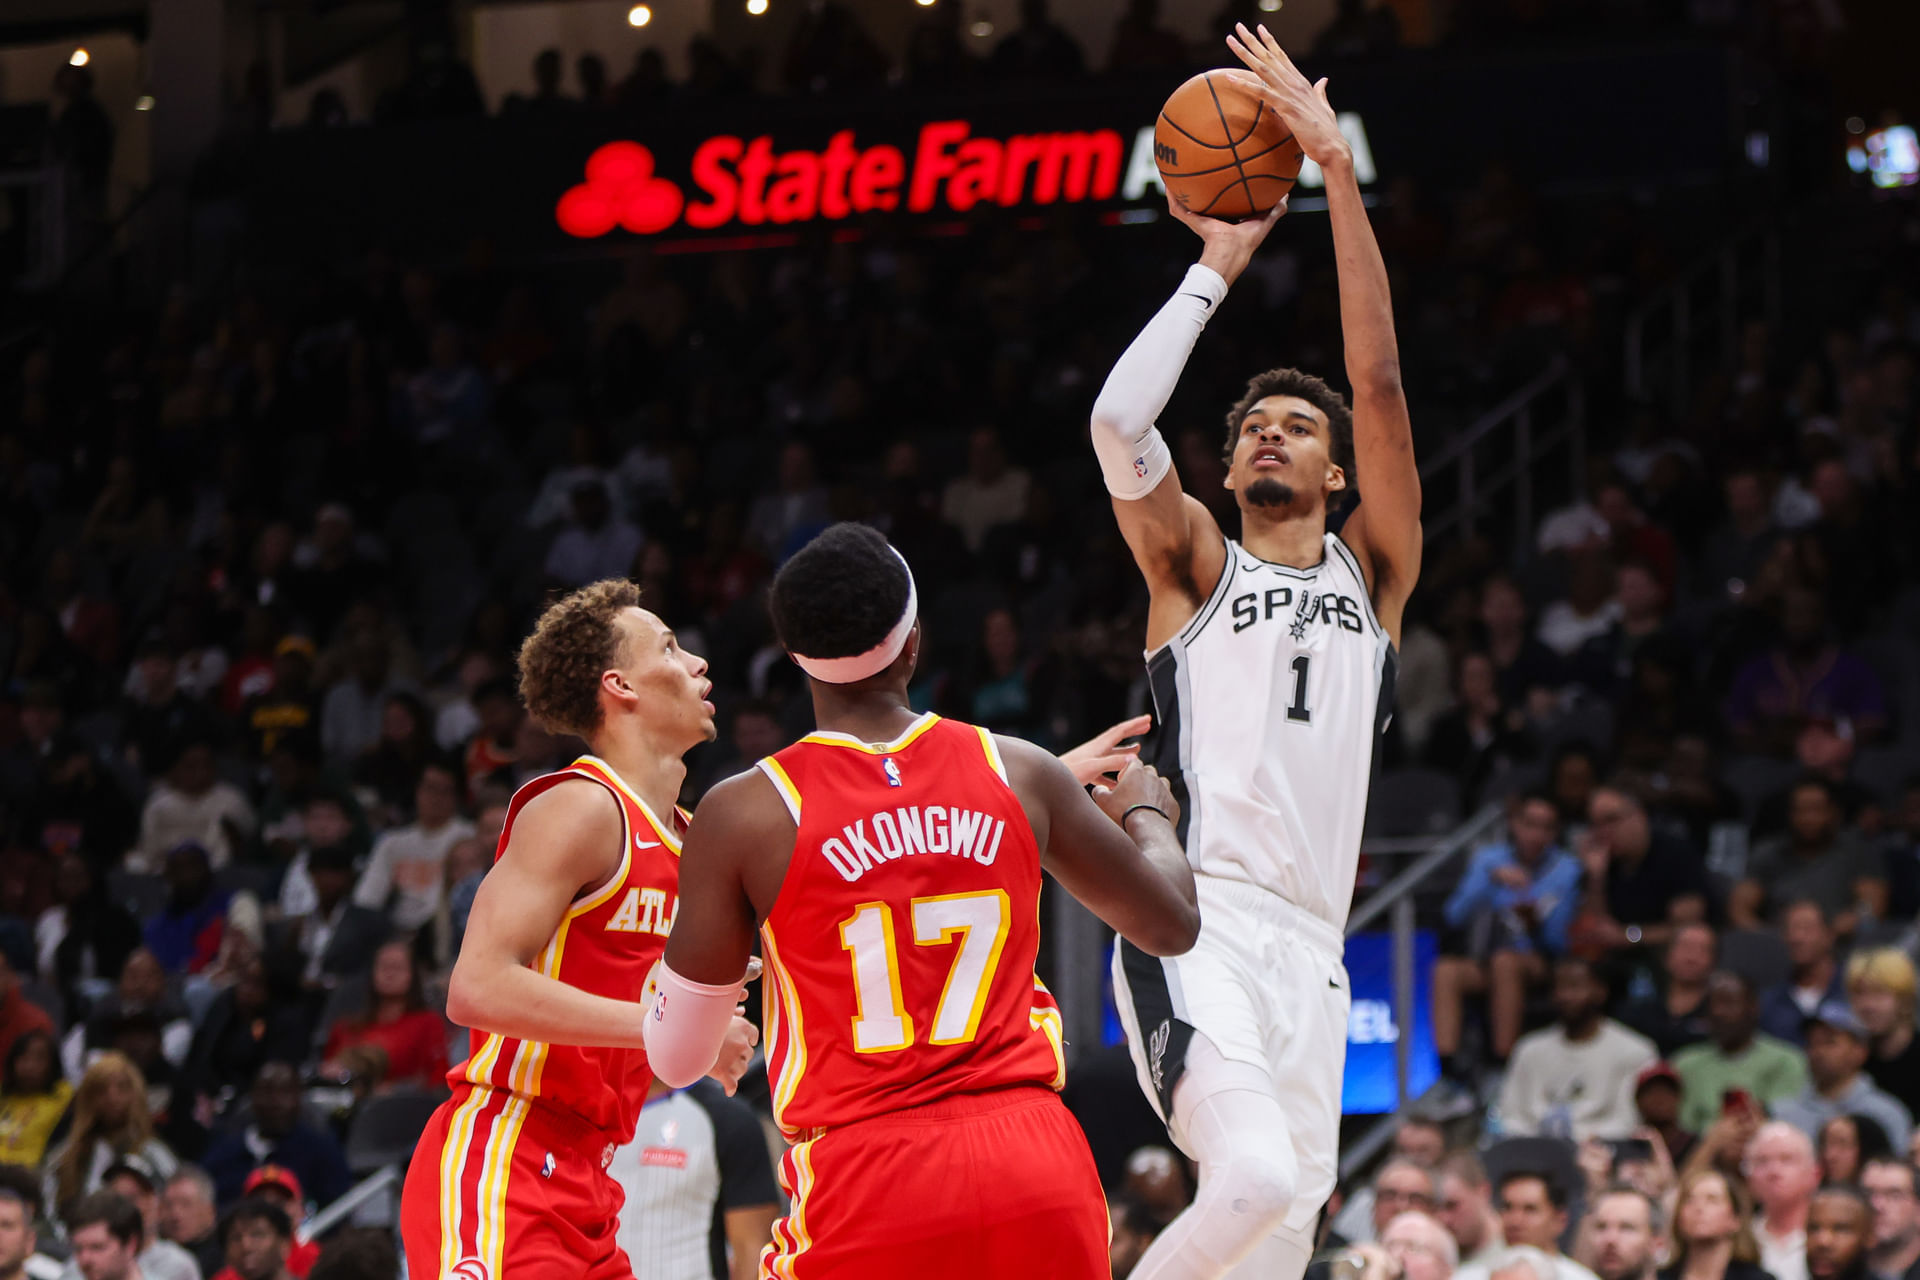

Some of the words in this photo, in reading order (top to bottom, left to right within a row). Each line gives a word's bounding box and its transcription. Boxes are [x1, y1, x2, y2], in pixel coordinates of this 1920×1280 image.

[685, 129, 905, 229] State
[908, 119, 1123, 213] Farm
[1154, 138, 1178, 167] on
[1285, 654, 1312, 725] 1
[821, 805, 1005, 882] OKONGWU
[604, 887, 680, 938] ATL
[838, 888, 1012, 1054] 17
